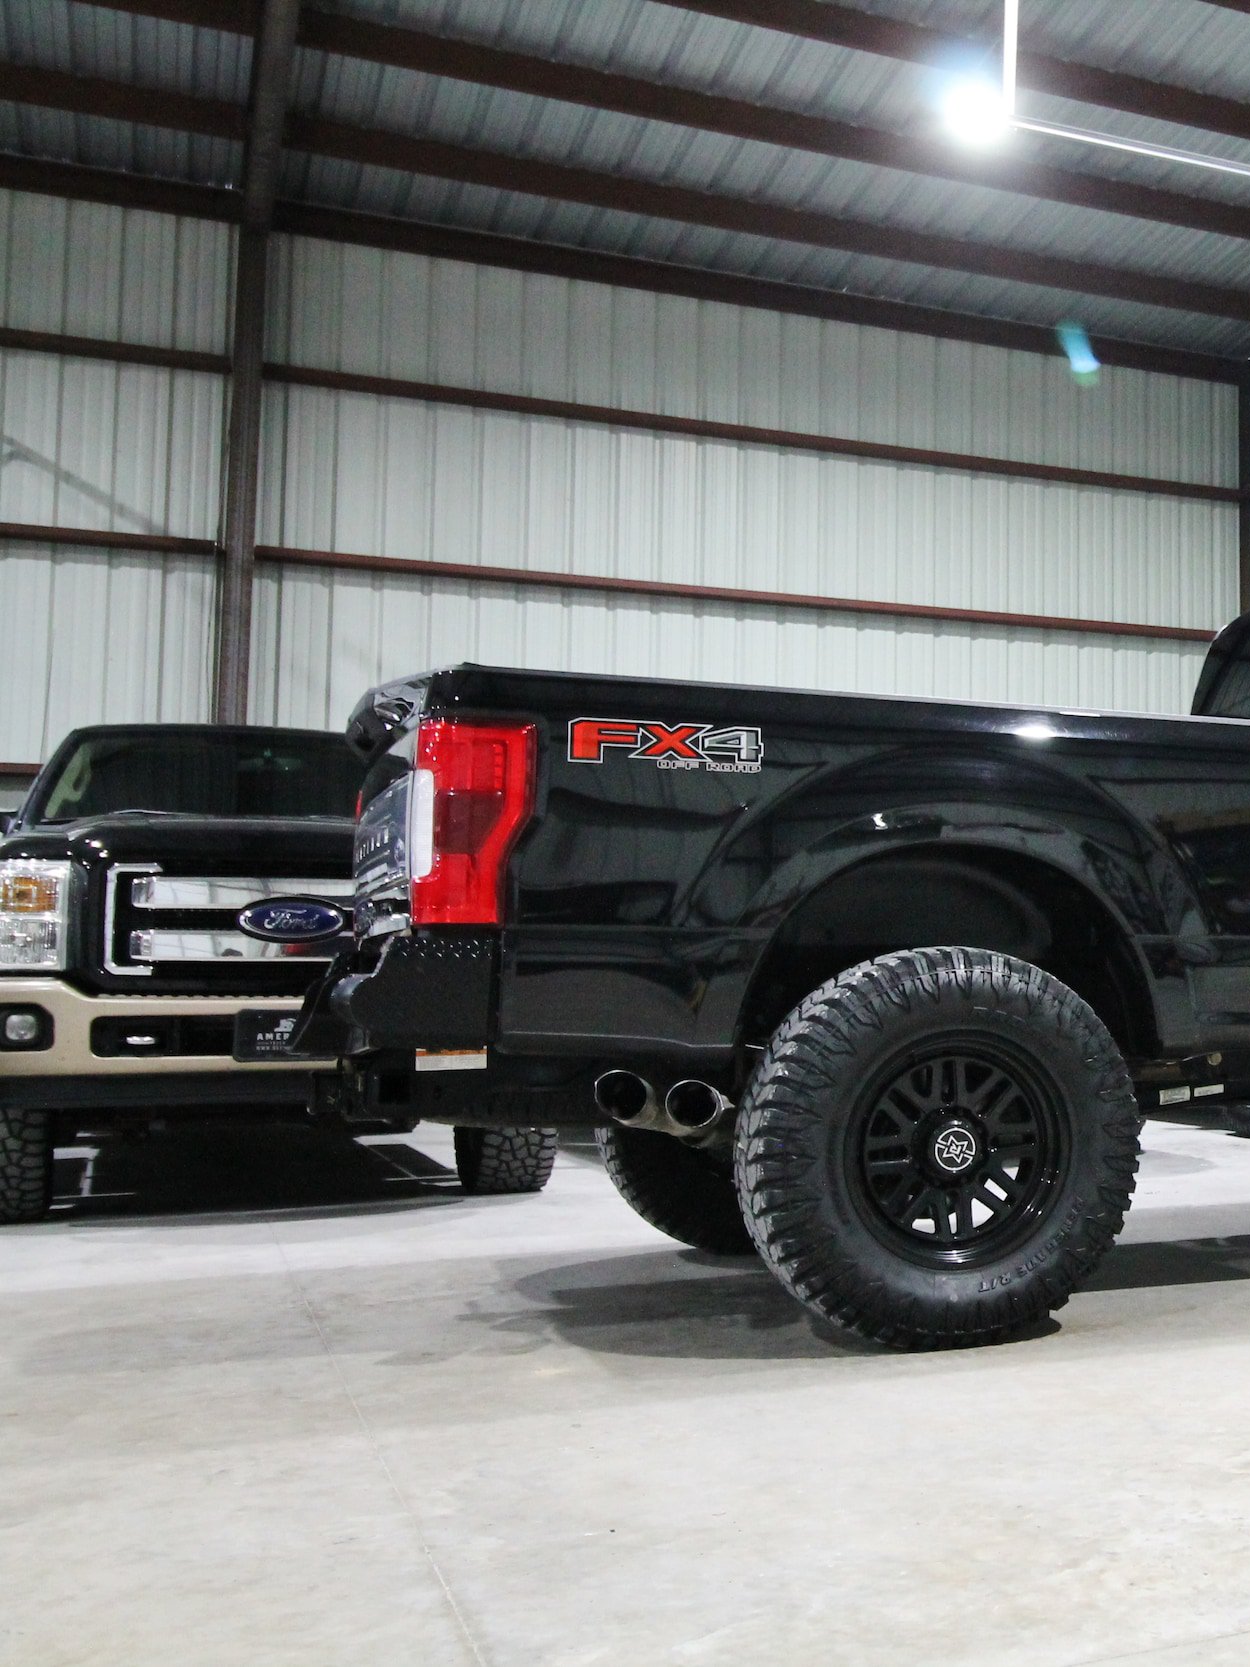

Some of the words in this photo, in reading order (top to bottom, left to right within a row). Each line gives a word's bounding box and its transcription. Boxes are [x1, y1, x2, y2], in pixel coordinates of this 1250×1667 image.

[568, 717, 764, 763] FX4
[656, 760, 700, 770] OFF
[706, 762, 762, 774] ROAD
[263, 908, 320, 930] Ford
